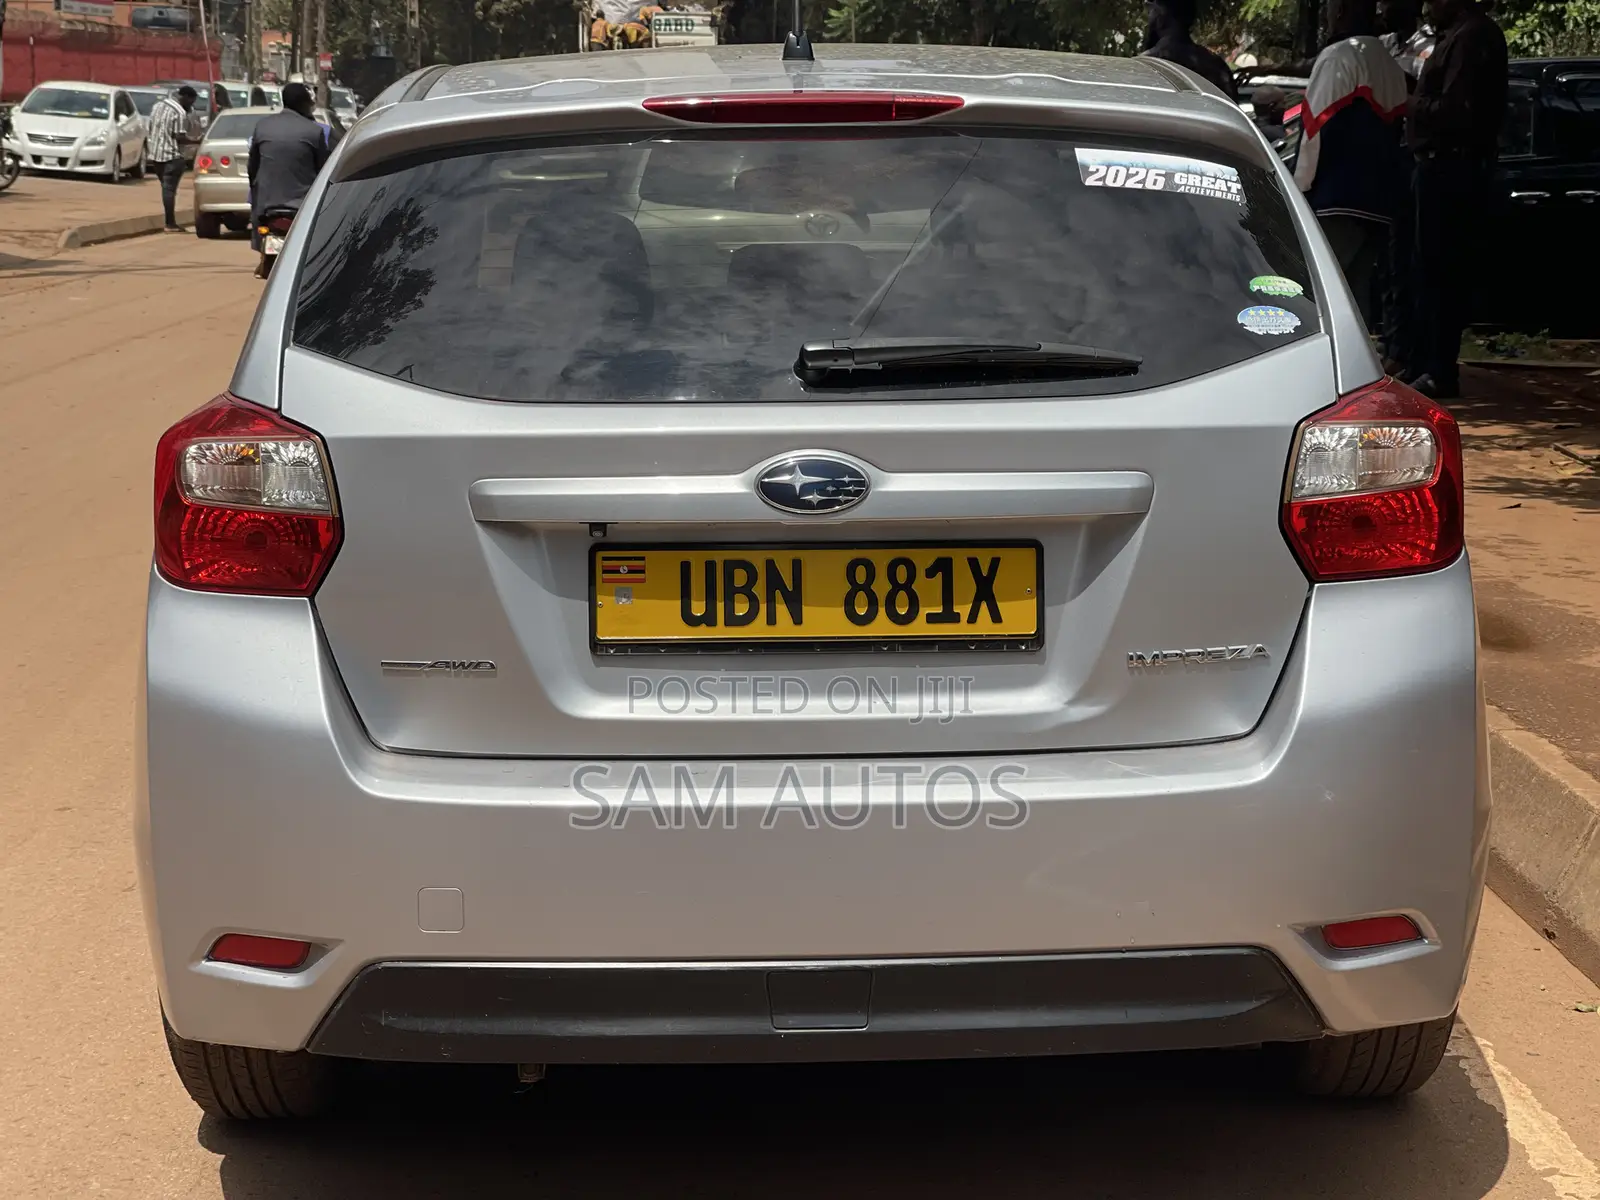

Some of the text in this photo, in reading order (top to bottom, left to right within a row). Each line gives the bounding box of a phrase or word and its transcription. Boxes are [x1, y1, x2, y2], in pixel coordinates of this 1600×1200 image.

[1084, 165, 1166, 191] 2026
[1173, 172, 1242, 194] GREAT
[1177, 185, 1241, 202] ACHIEVEMENTS
[680, 556, 1004, 627] UBN 881X
[424, 659, 497, 672] AWD
[1127, 643, 1271, 668] IMPREZA
